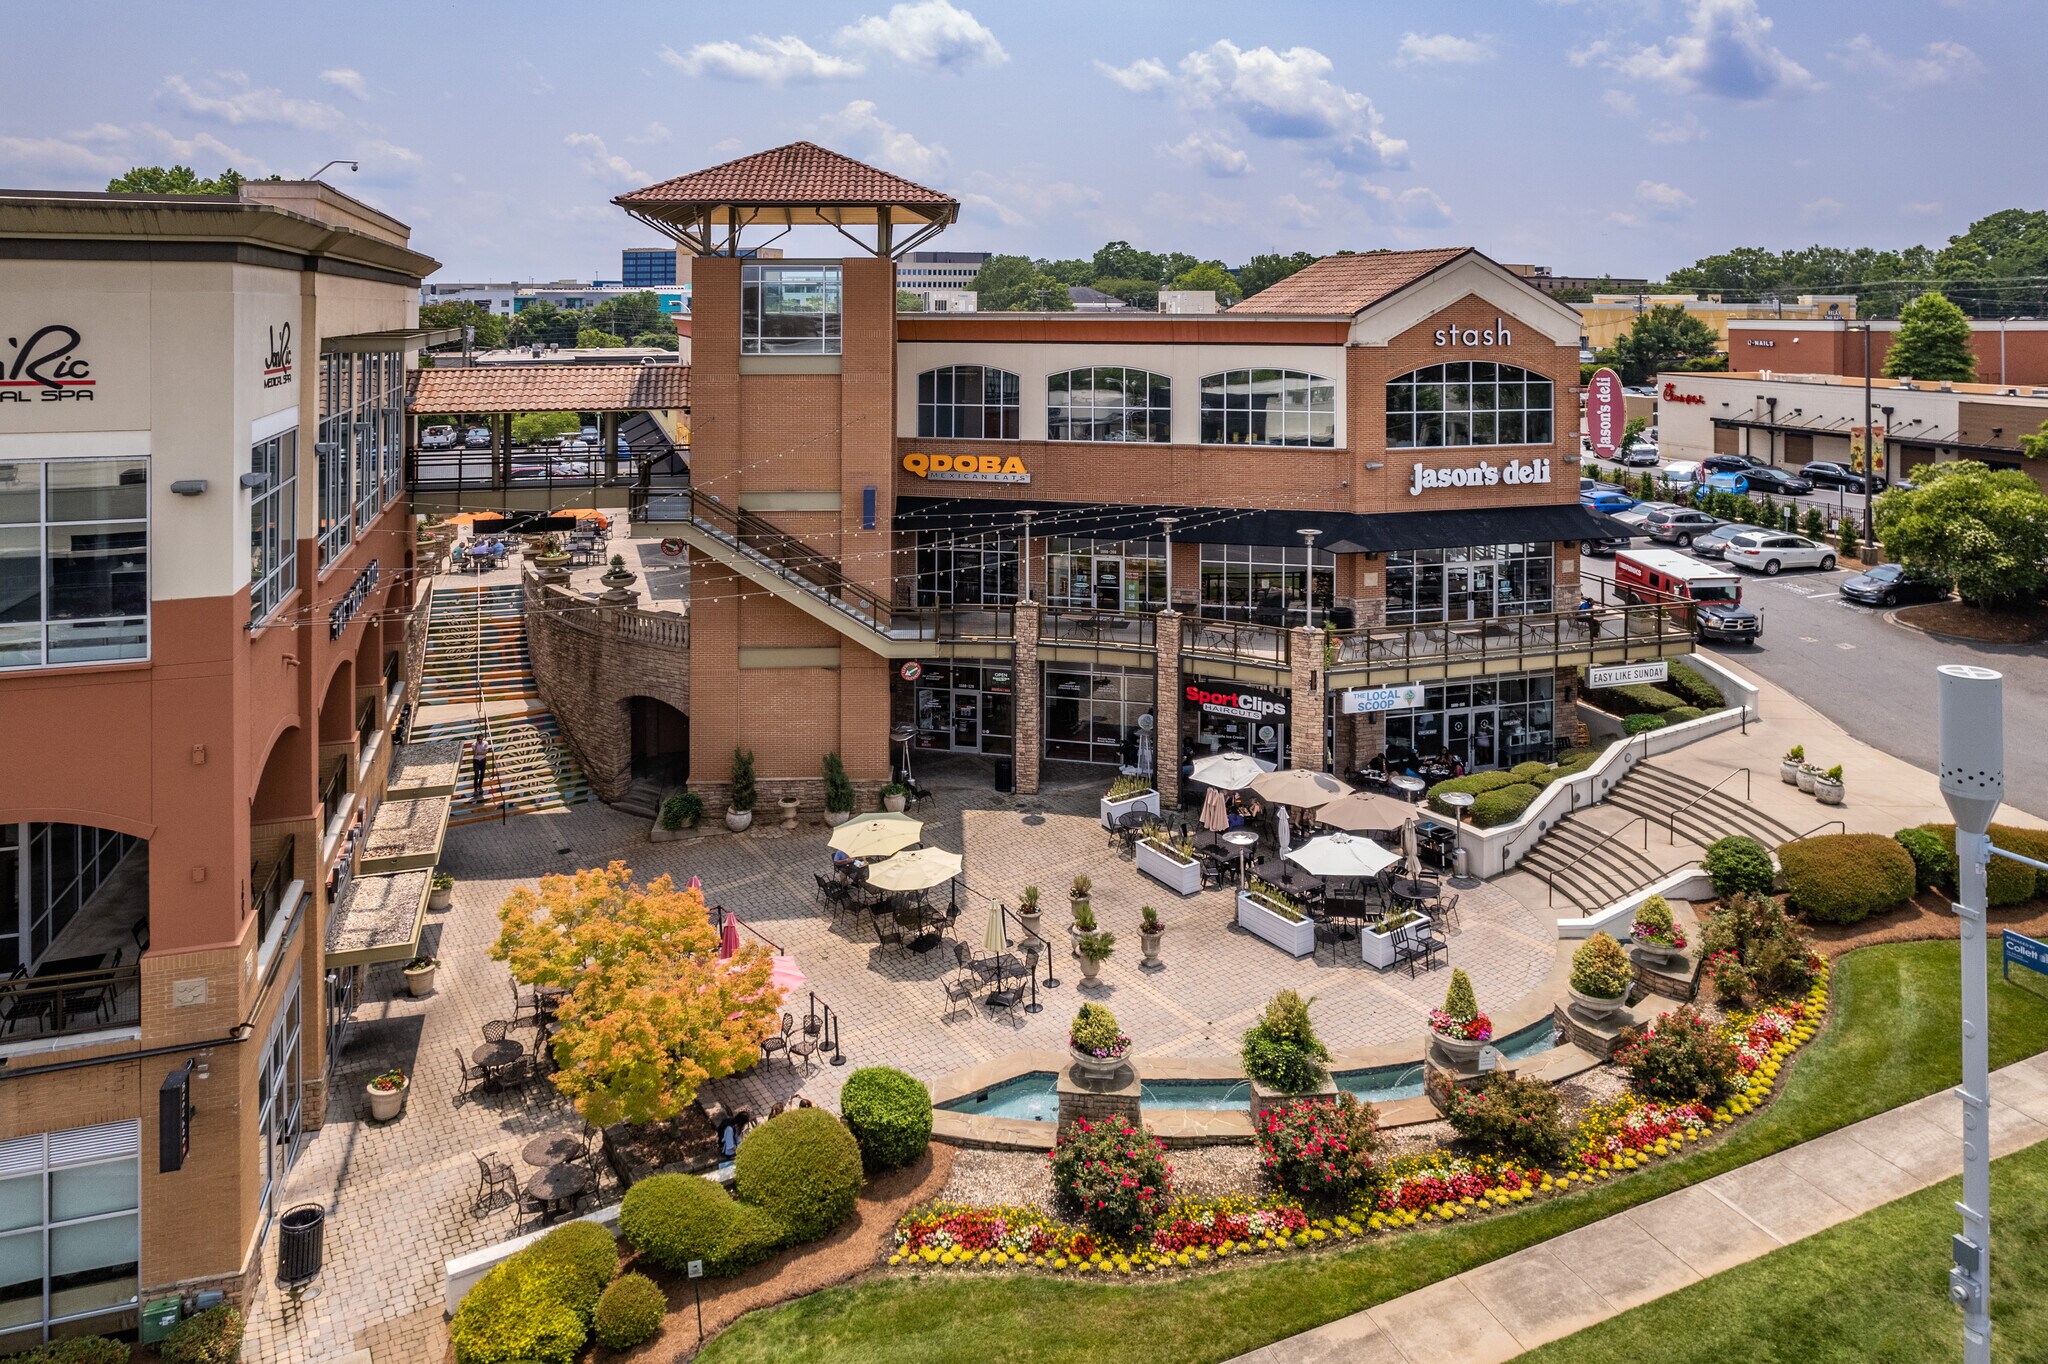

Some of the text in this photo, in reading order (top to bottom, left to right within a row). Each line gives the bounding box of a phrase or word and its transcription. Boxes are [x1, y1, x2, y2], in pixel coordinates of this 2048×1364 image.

[1435, 318, 1511, 346] stash
[264, 374, 291, 389] MEDICAL SPA
[41, 390, 93, 401] SPA
[1596, 377, 1615, 451] Jason's deli
[903, 453, 1028, 478] QDOBA
[930, 472, 988, 480] MEXICAN
[1410, 458, 1551, 496] Jason's deli
[1593, 667, 1664, 683] EASY LIKE SUNDAY
[1366, 690, 1401, 701] LOCAL
[1204, 704, 1261, 719] HAIRCUTS
[1357, 699, 1395, 711] SCOOP
[2006, 941, 2038, 960] Collett
